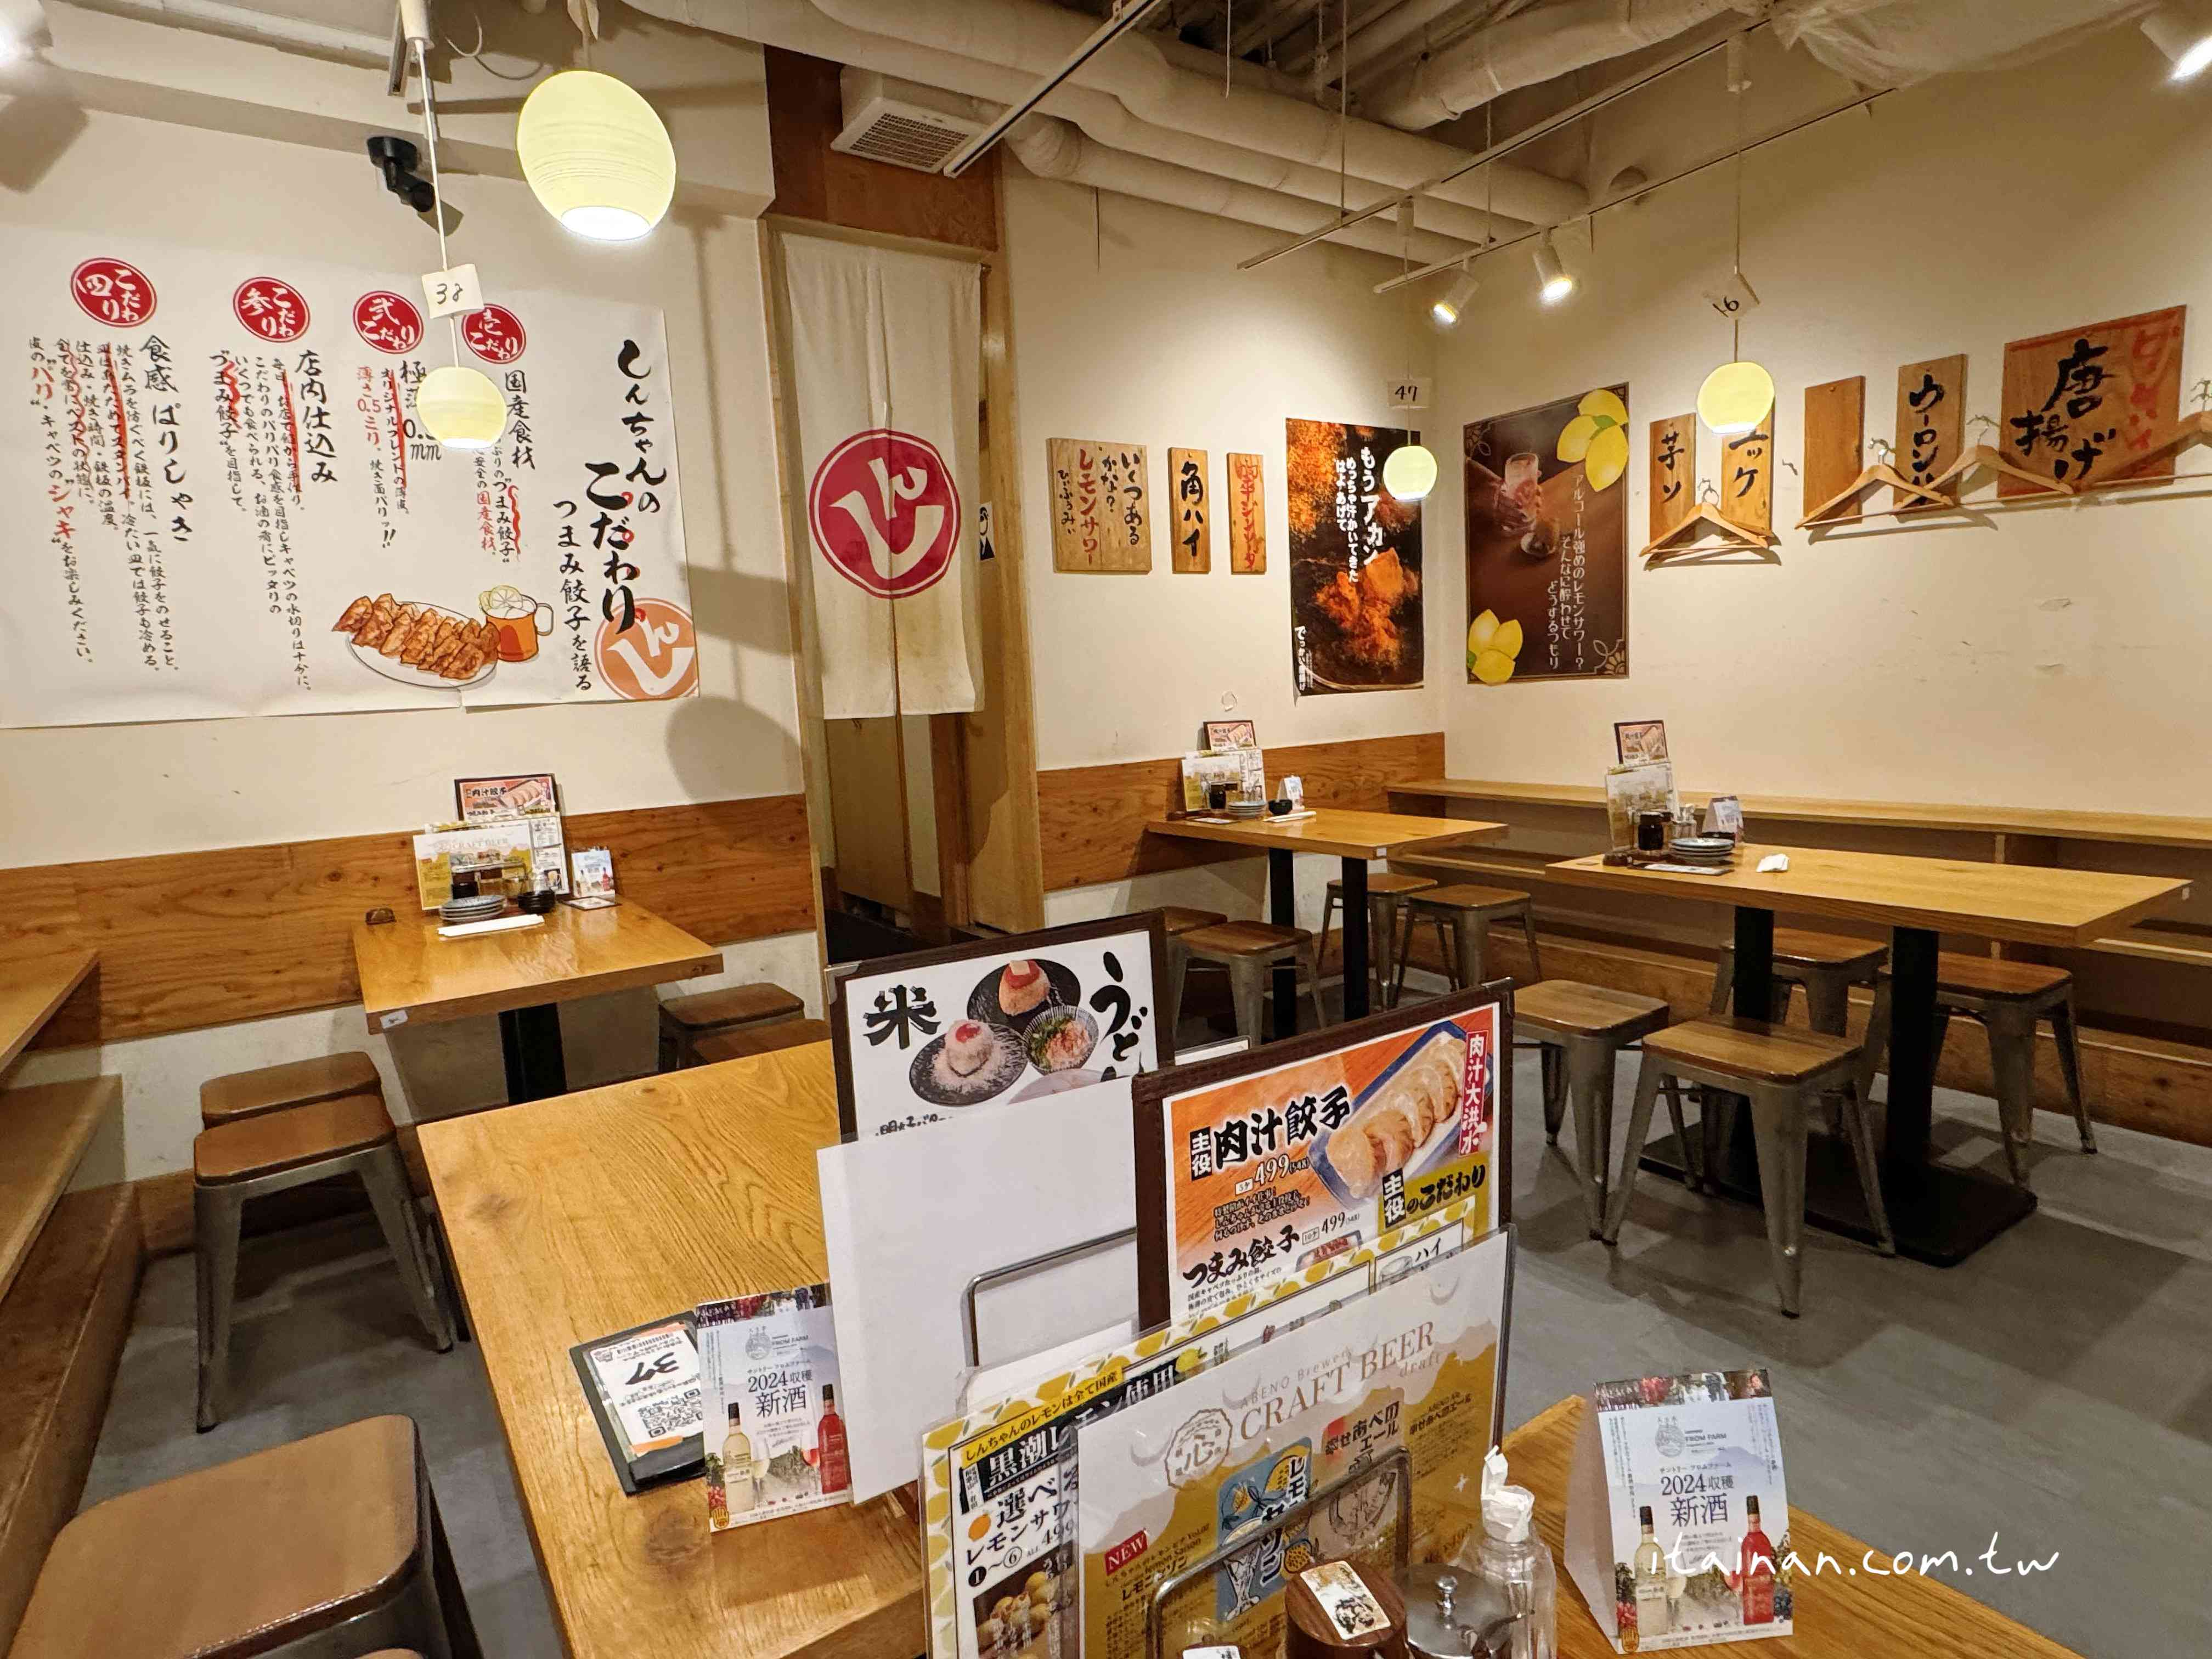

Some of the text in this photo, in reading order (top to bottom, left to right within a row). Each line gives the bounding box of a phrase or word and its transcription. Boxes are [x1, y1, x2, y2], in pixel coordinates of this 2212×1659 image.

[295, 349, 338, 483] 店内仕込み
[505, 369, 535, 470] 国産食材
[618, 339, 667, 513] しんちゃんの
[1395, 385, 1418, 402] 47
[2010, 338, 2117, 481] 唐揚げ
[1078, 449, 1099, 566] レモンサワー
[1121, 452, 1143, 545] いくつある
[1181, 461, 1204, 557] 角ハイ
[586, 462, 639, 634] こだわり
[864, 984, 941, 1050] 米
[1191, 1086, 1351, 1178] 主役 肉汁餃子
[1460, 1034, 1486, 1154] 肉汁大洪水
[1254, 1153, 1289, 1186] 499
[1384, 1164, 1485, 1226] 主役 のこだわり
[1183, 1224, 1300, 1288] つまみ餃子
[1322, 1212, 1345, 1234] 499
[748, 1370, 788, 1393] 2024
[755, 1384, 806, 1418] 新酒
[1241, 1361, 1351, 1440] CRAFT
[1360, 1321, 1434, 1381] BEER
[1661, 1474, 1707, 1496] 2024
[1670, 1492, 1728, 1528] 新酒
[967, 1499, 1078, 1565] レモンサワ
[1108, 1536, 1145, 1571] NEW
